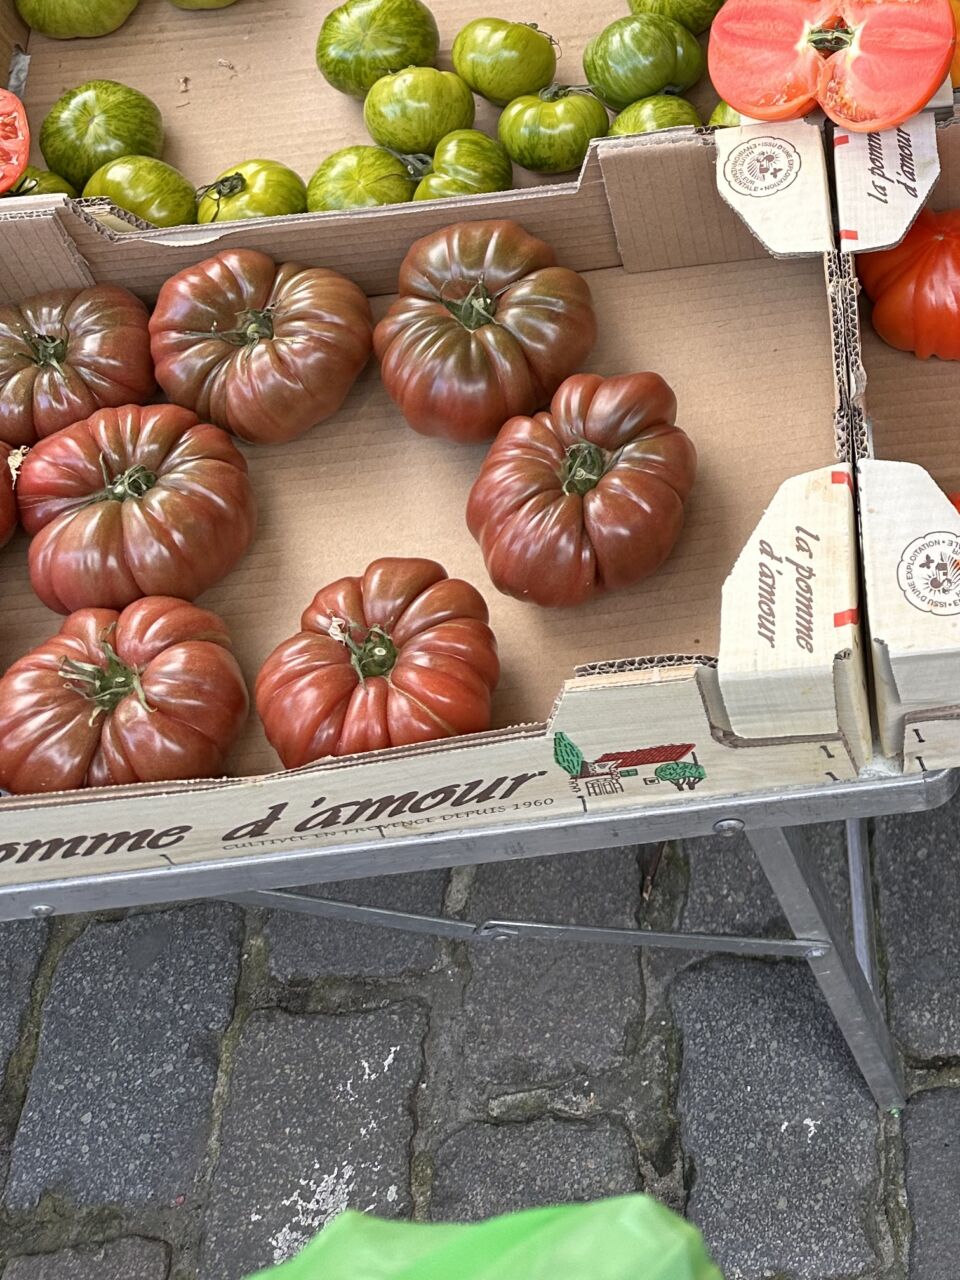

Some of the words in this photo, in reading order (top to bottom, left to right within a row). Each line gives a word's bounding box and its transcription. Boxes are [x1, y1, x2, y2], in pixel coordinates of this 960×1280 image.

[867, 131, 895, 184] pomm
[896, 128, 919, 199] d'amour
[866, 180, 889, 205] la
[794, 525, 820, 560] la
[905, 539, 941, 580] EXPLOITATION
[757, 538, 784, 649] d'amour
[785, 556, 818, 654] pomme
[907, 580, 928, 602] D'UNE
[221, 770, 548, 842] d'amour
[440, 806, 507, 823] DEPUIS
[513, 797, 556, 812] 1960
